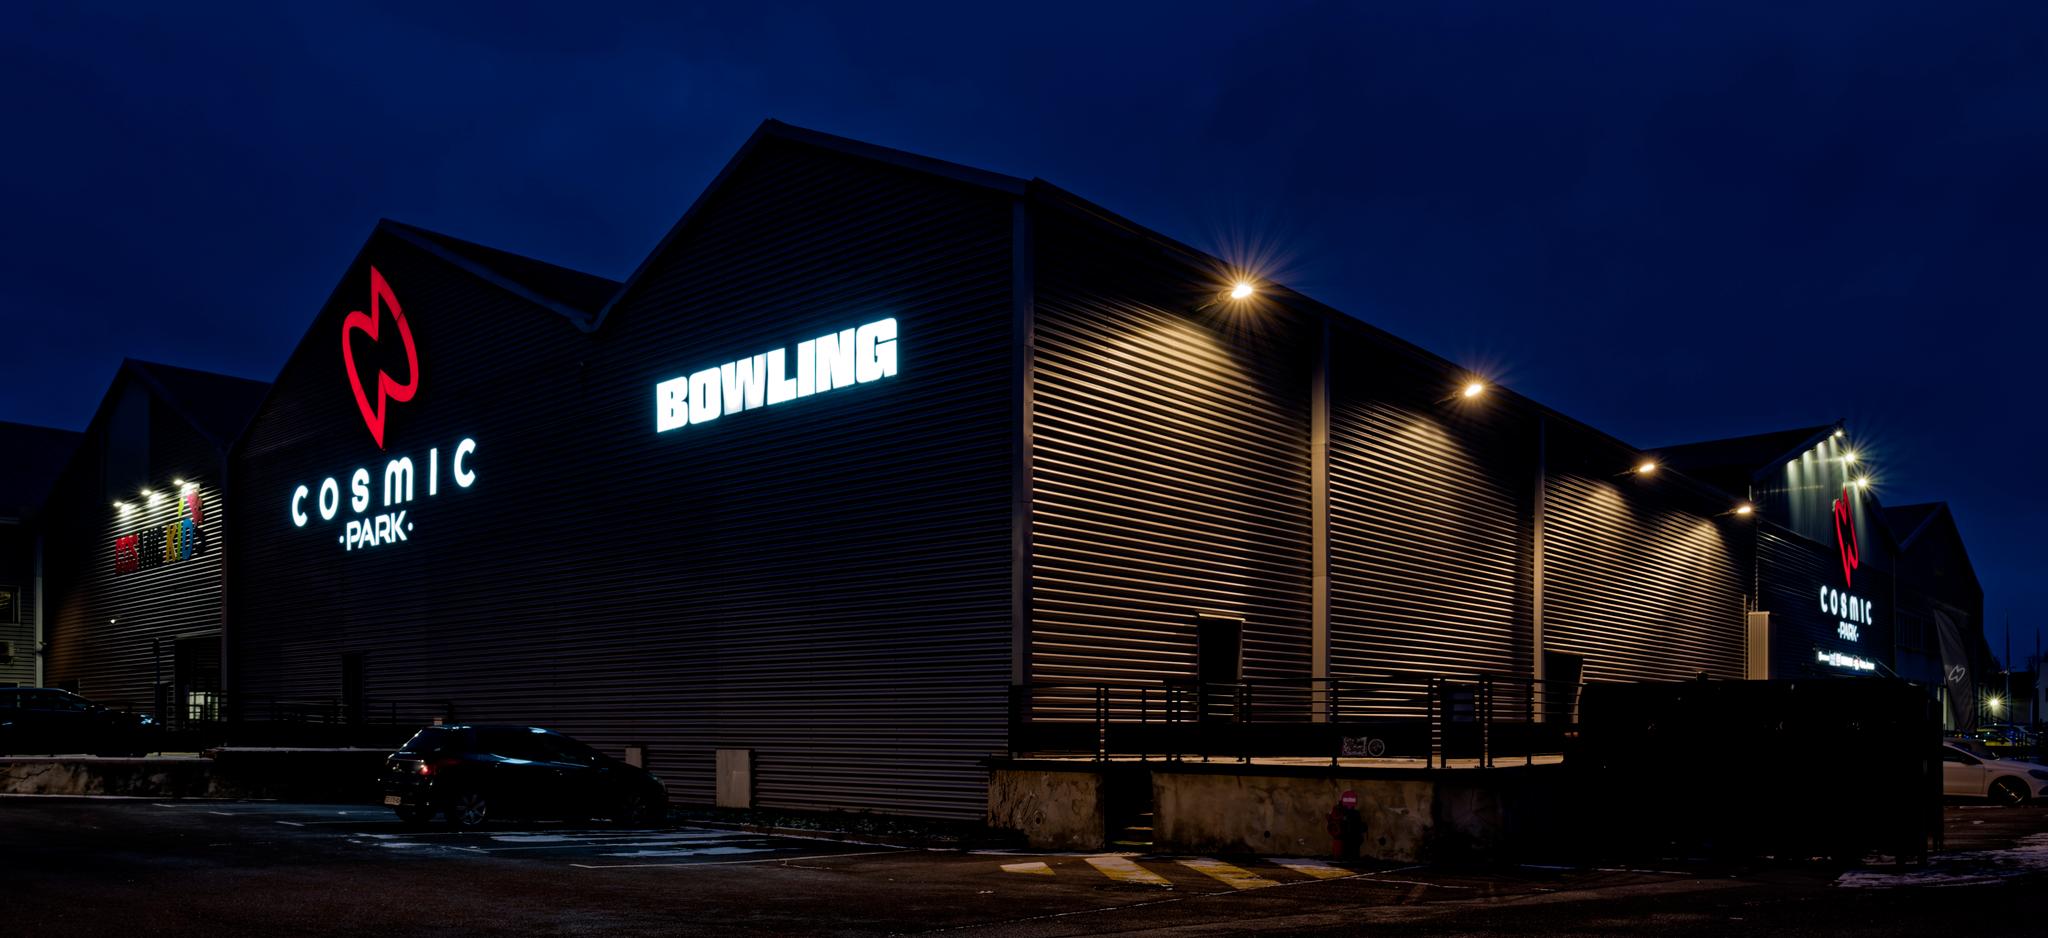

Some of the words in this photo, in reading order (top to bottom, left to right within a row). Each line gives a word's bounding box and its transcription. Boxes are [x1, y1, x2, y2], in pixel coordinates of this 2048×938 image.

[656, 317, 898, 433] BOWLING
[291, 437, 476, 527] COSMIC
[1820, 585, 1872, 625] COSMIC
